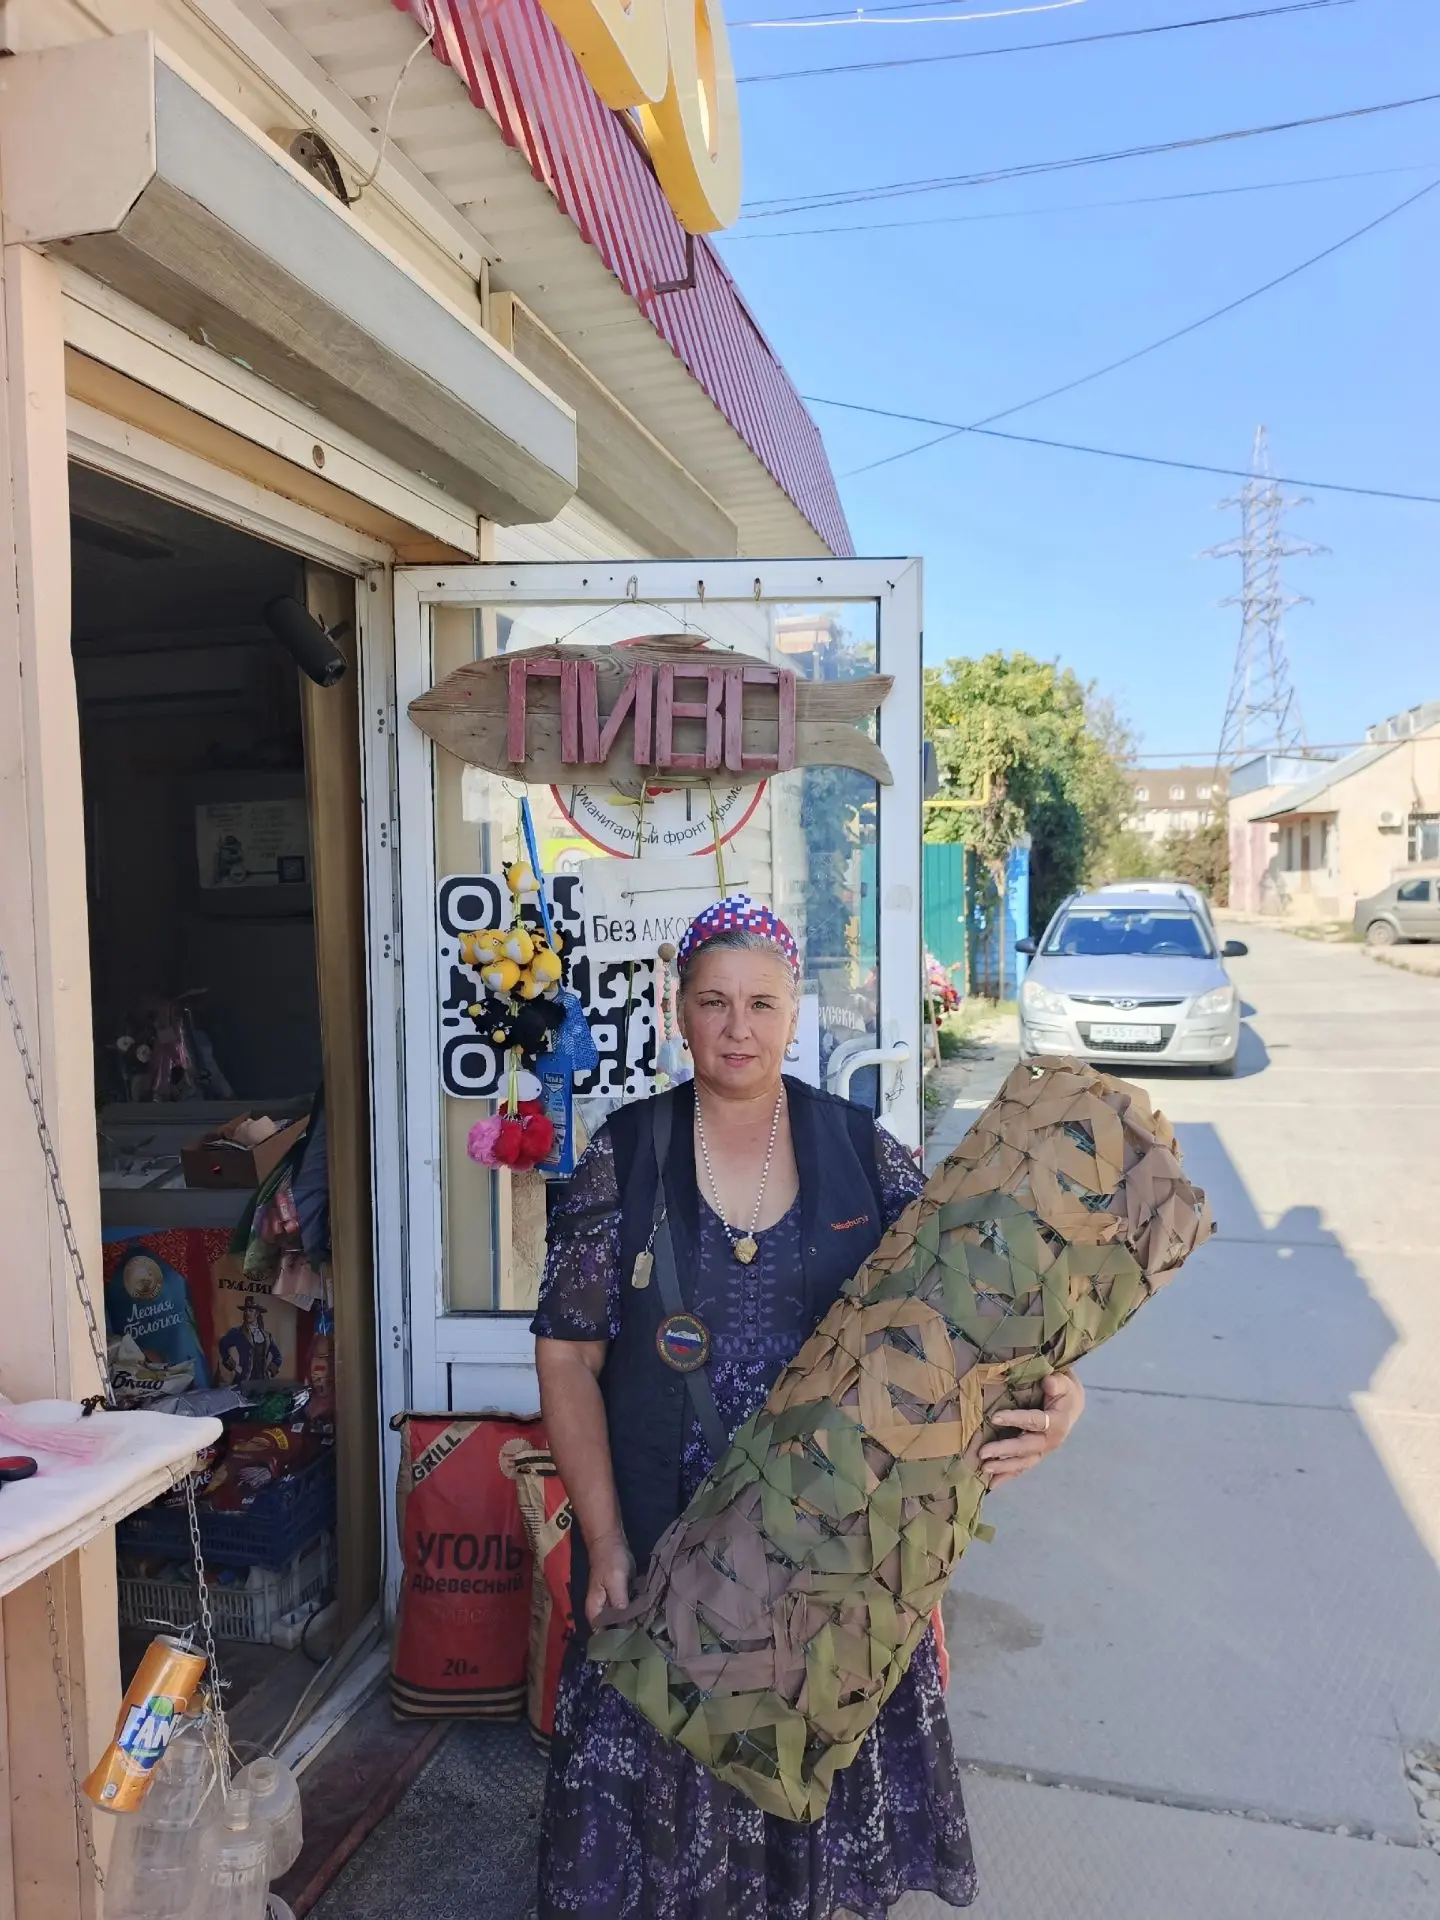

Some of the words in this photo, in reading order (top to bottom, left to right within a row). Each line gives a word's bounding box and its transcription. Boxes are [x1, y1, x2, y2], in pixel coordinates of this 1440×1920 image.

[508, 657, 796, 772] ПИВО
[576, 786, 659, 844] уманитарный
[664, 820, 707, 845] фронт
[593, 915, 637, 943] Без
[127, 1300, 175, 1322] Лесная
[412, 1434, 462, 1481] GRILL
[416, 1530, 523, 1572] УГОЛЬ
[118, 1706, 180, 1748] FAN
